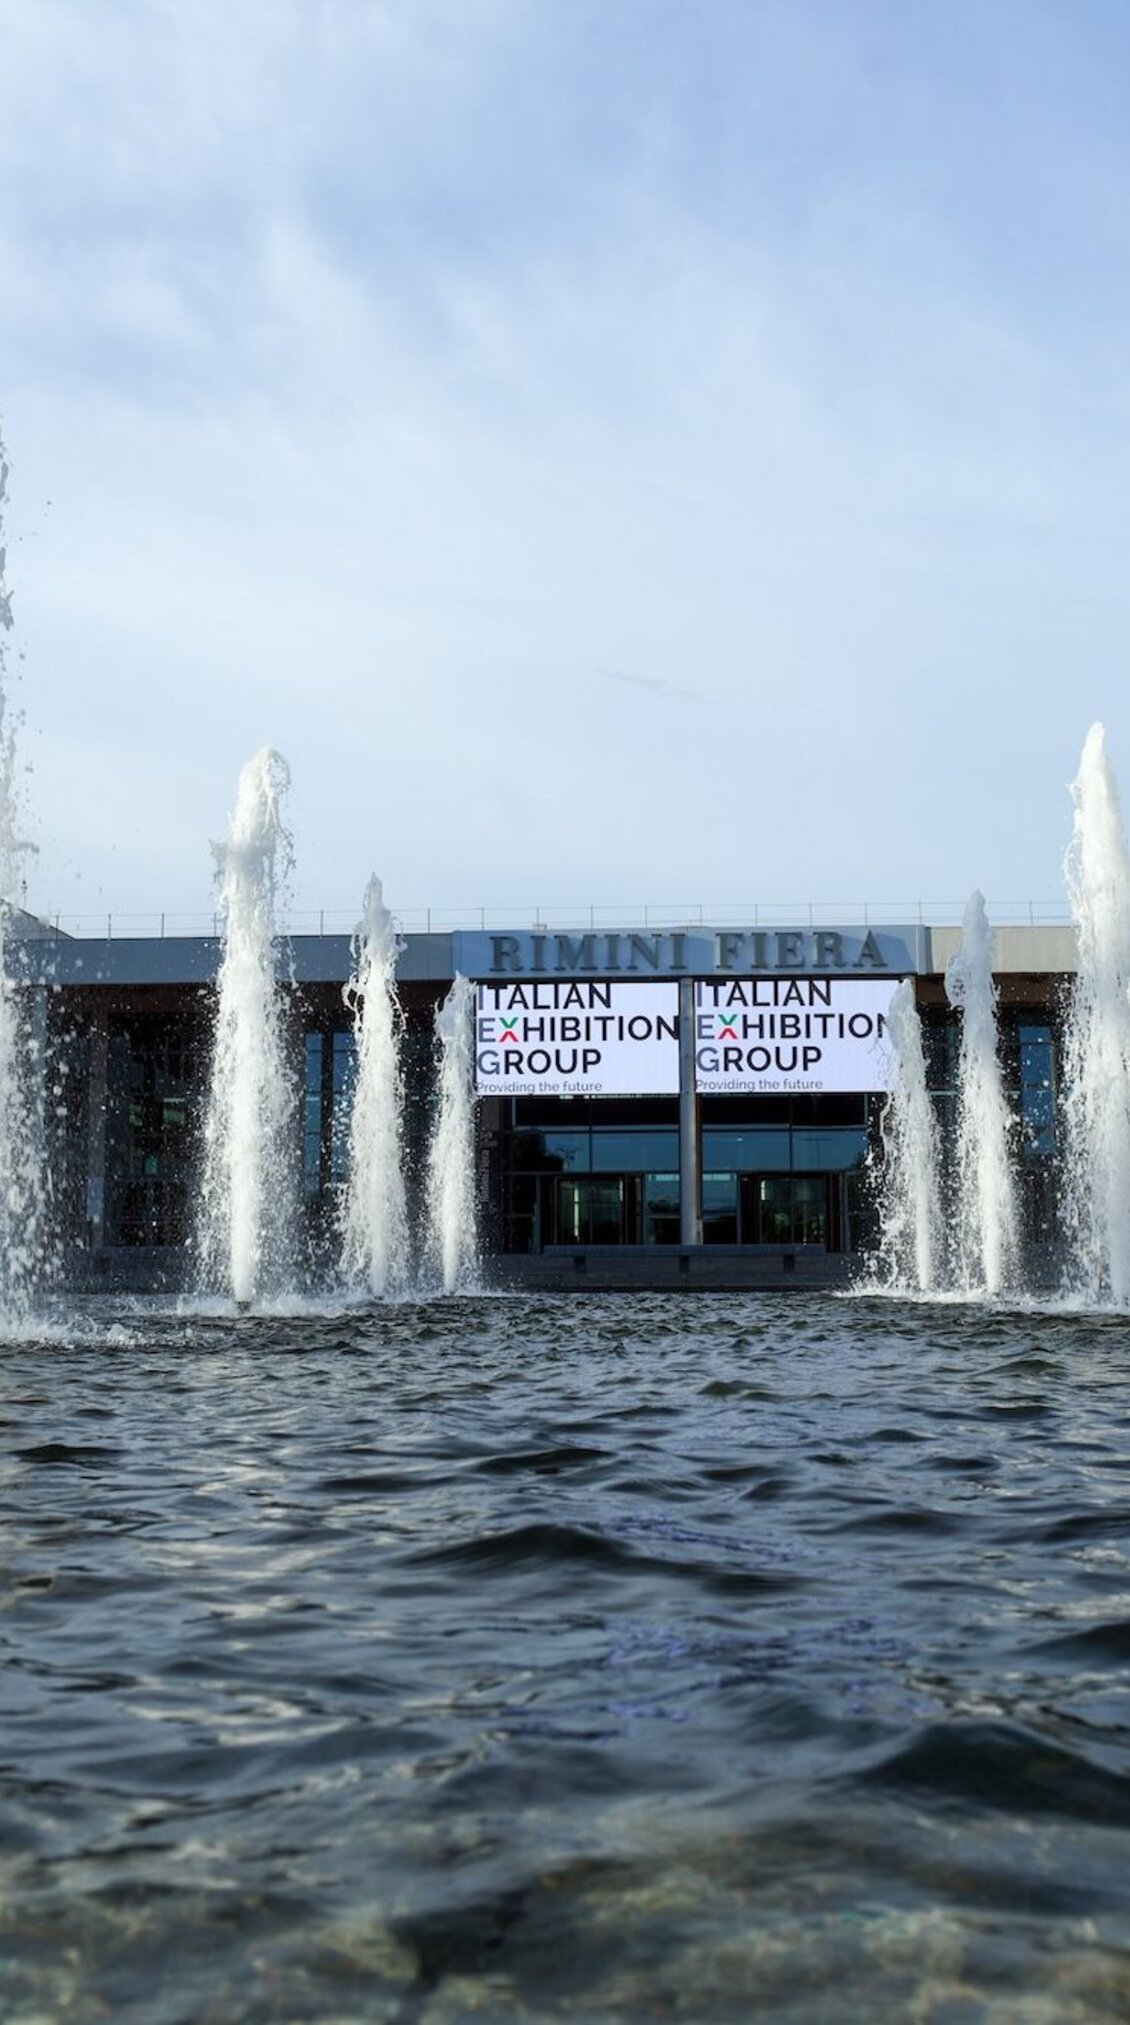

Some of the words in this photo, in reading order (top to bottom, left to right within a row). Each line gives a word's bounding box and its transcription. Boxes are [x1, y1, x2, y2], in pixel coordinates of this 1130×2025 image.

[488, 933, 688, 972] RIMINI
[714, 930, 888, 969] FIERA
[478, 983, 612, 1010] ITALIAN
[696, 980, 832, 1007] ITALIAN
[478, 1015, 680, 1043] EXHIBITION
[477, 1048, 602, 1075] GROUP
[696, 1046, 822, 1072] GROUP
[476, 1081, 536, 1094] Providing
[538, 1081, 560, 1092] the
[562, 1081, 603, 1092] future
[696, 1079, 756, 1091] Providing
[758, 1079, 780, 1090] the
[783, 1079, 823, 1090] future
